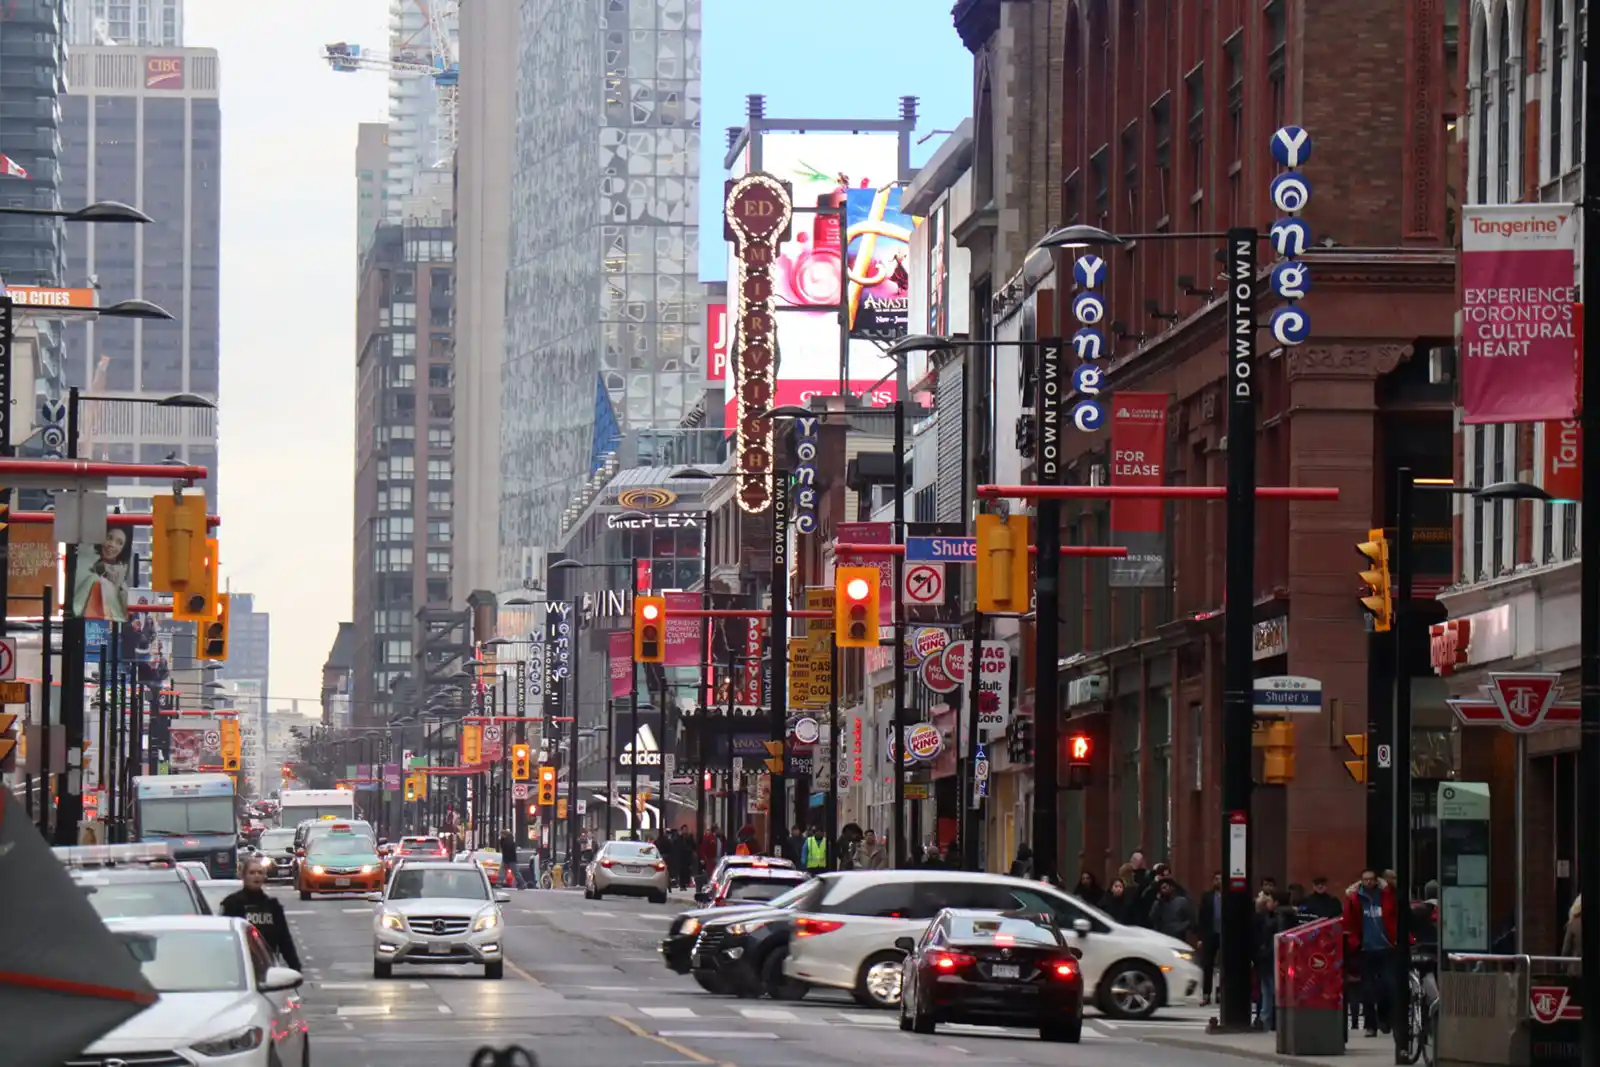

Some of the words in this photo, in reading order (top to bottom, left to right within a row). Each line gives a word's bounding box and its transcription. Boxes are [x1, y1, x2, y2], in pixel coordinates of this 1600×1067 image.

[148, 59, 181, 72] CIBC
[744, 200, 774, 216] ED
[1469, 215, 1557, 237] Tangerine
[1271, 127, 1309, 345] Yonge
[30, 291, 70, 305] CITIES
[1464, 287, 1575, 304] EXPERIENCE
[1236, 240, 1250, 396] DOWNTOWN
[1463, 303, 1572, 322] TORONTO'S
[1478, 321, 1575, 339] CULTURAL
[1073, 255, 1104, 432] Yonge
[1468, 341, 1530, 357] HEART
[1044, 347, 1057, 473] DOWNTOWN
[1115, 450, 1144, 462] FOR
[796, 417, 818, 534] Yonge
[1115, 464, 1160, 476] LEASE
[775, 477, 784, 564] DOWNTOWN
[932, 539, 977, 556] Shute
[12, 559, 57, 568] CULTURA
[919, 632, 945, 643] BURGER
[919, 639, 946, 652] KING
[1265, 690, 1299, 702] Shuter
[911, 730, 937, 743] BURGER
[912, 737, 939, 751] KING
[245, 912, 274, 925] POLICE
